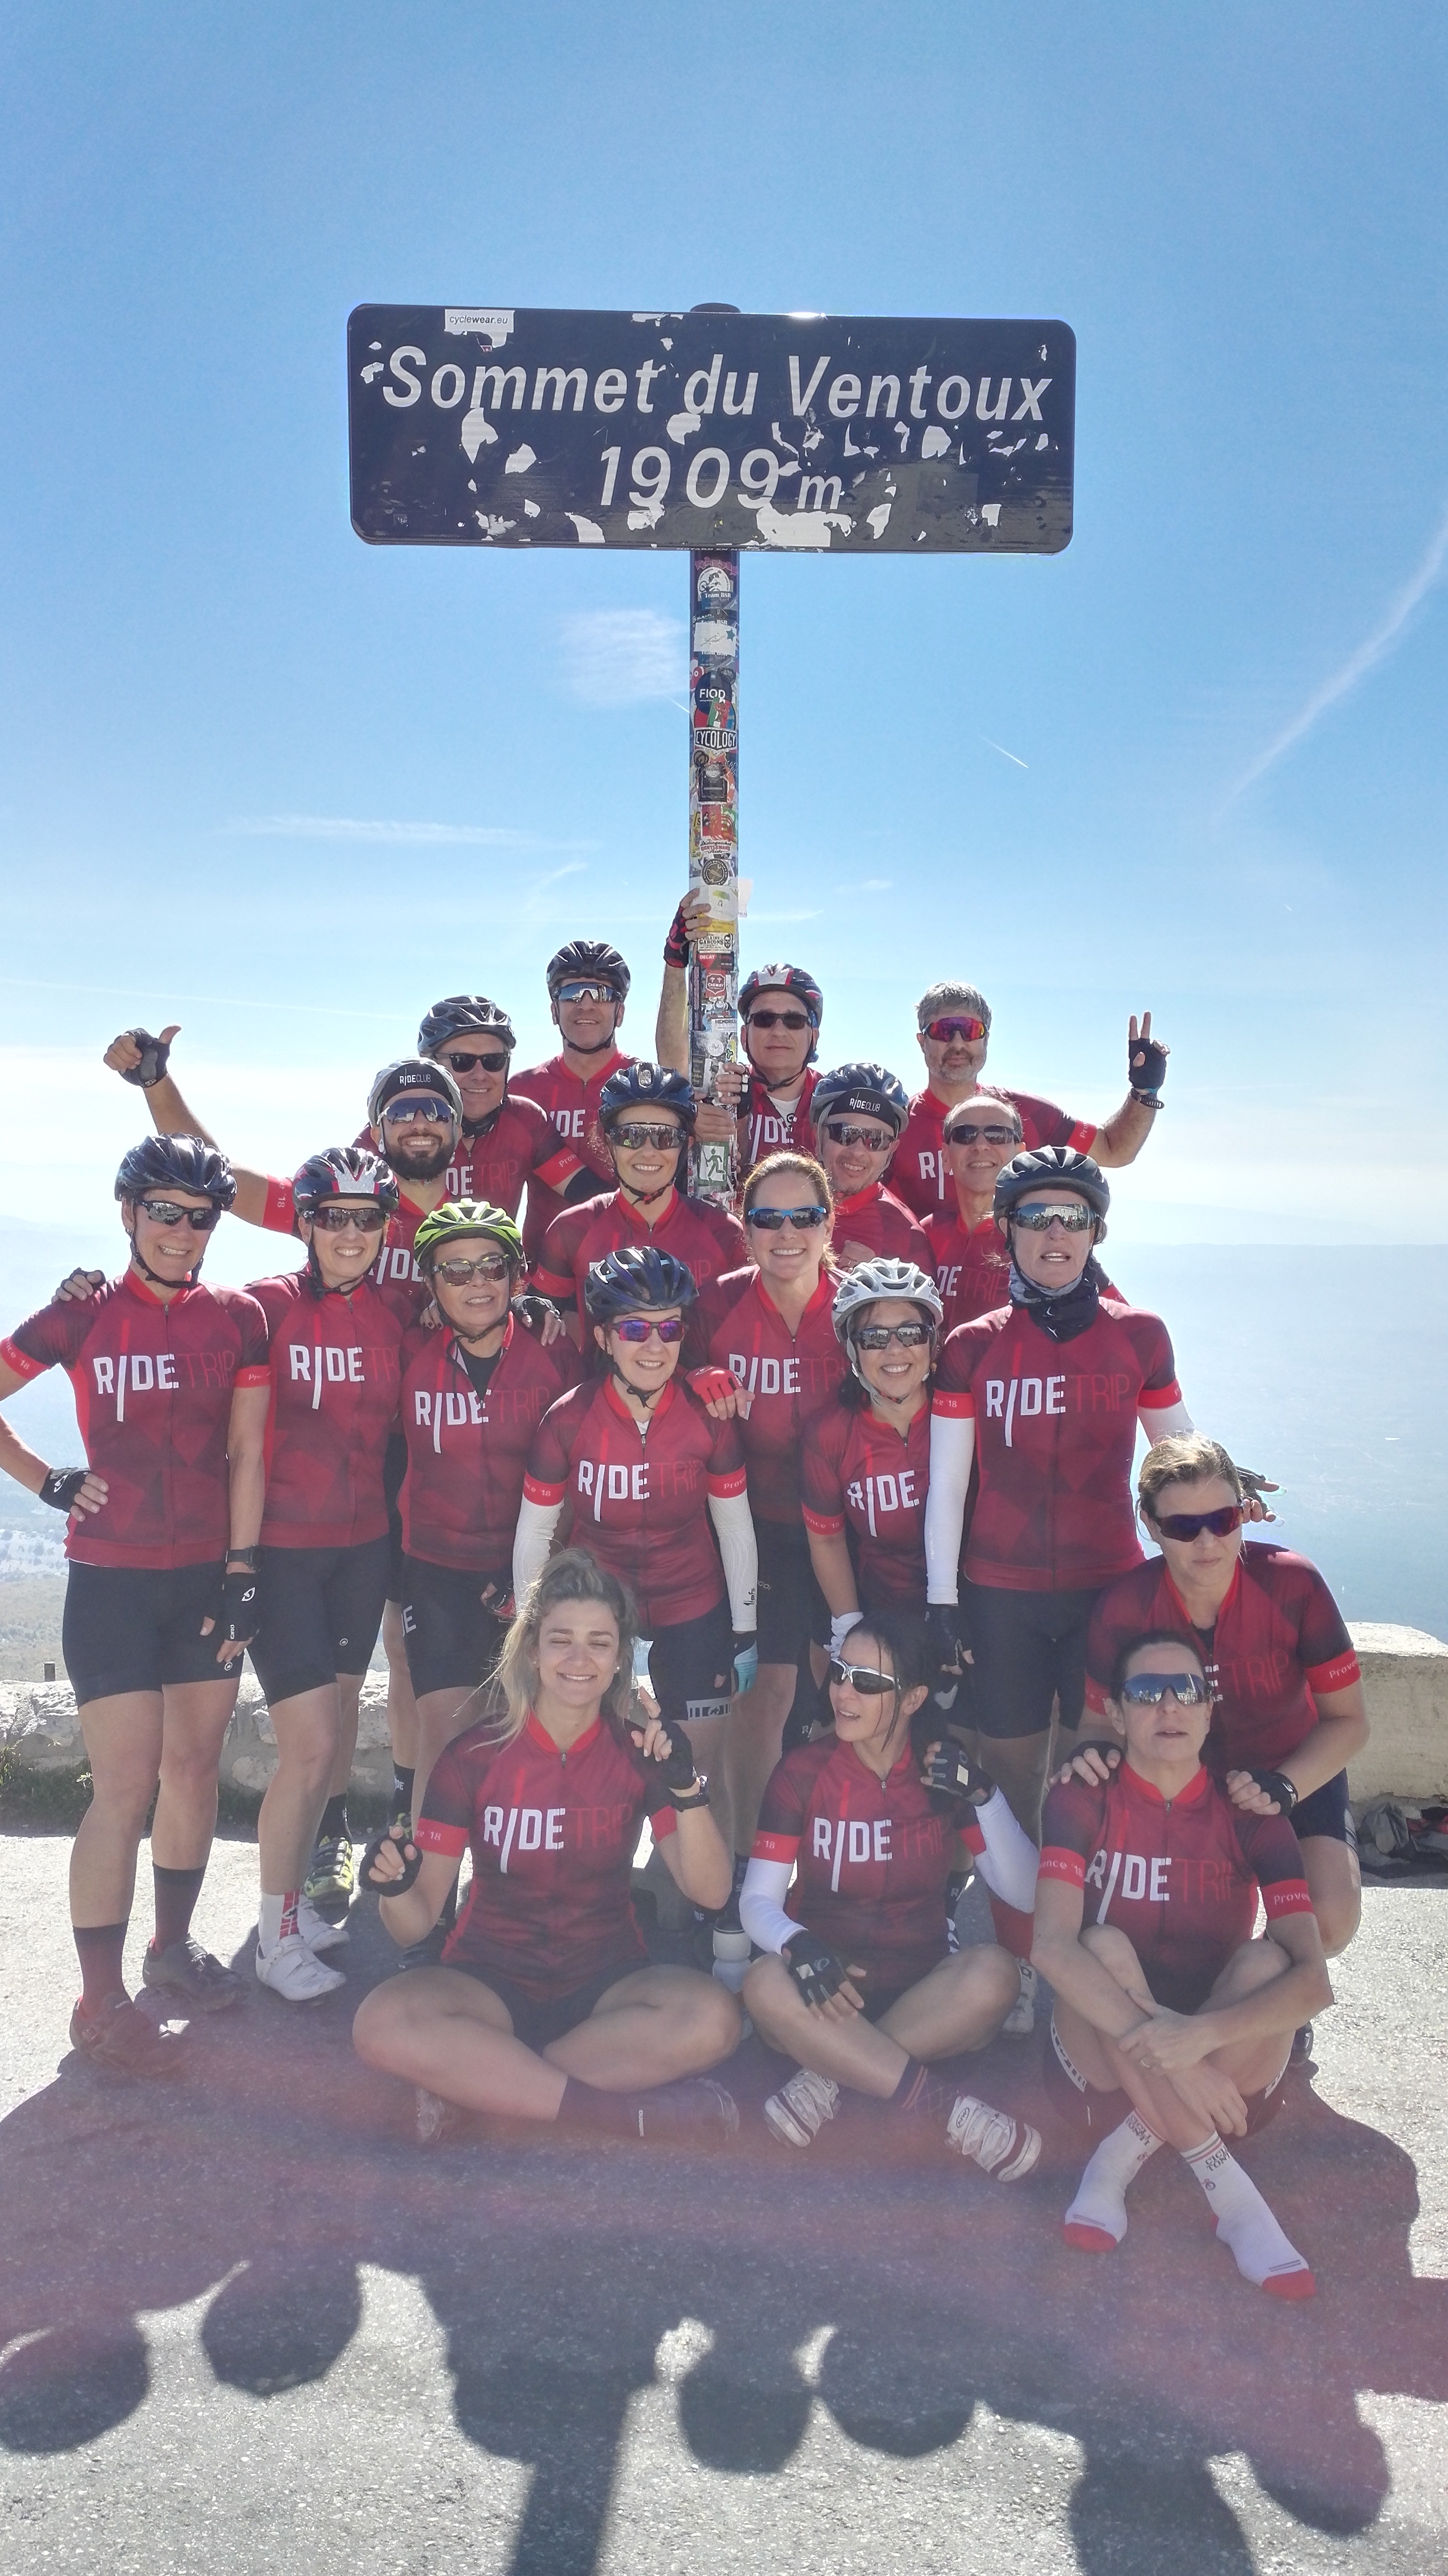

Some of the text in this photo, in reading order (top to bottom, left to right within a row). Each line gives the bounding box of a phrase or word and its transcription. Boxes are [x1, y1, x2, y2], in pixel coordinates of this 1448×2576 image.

[450, 314, 508, 325] cyclewear.eu
[382, 346, 1053, 421] Sommet du Ventoux
[600, 446, 842, 510] 1909 m
[696, 731, 736, 749] CYCOLOGY
